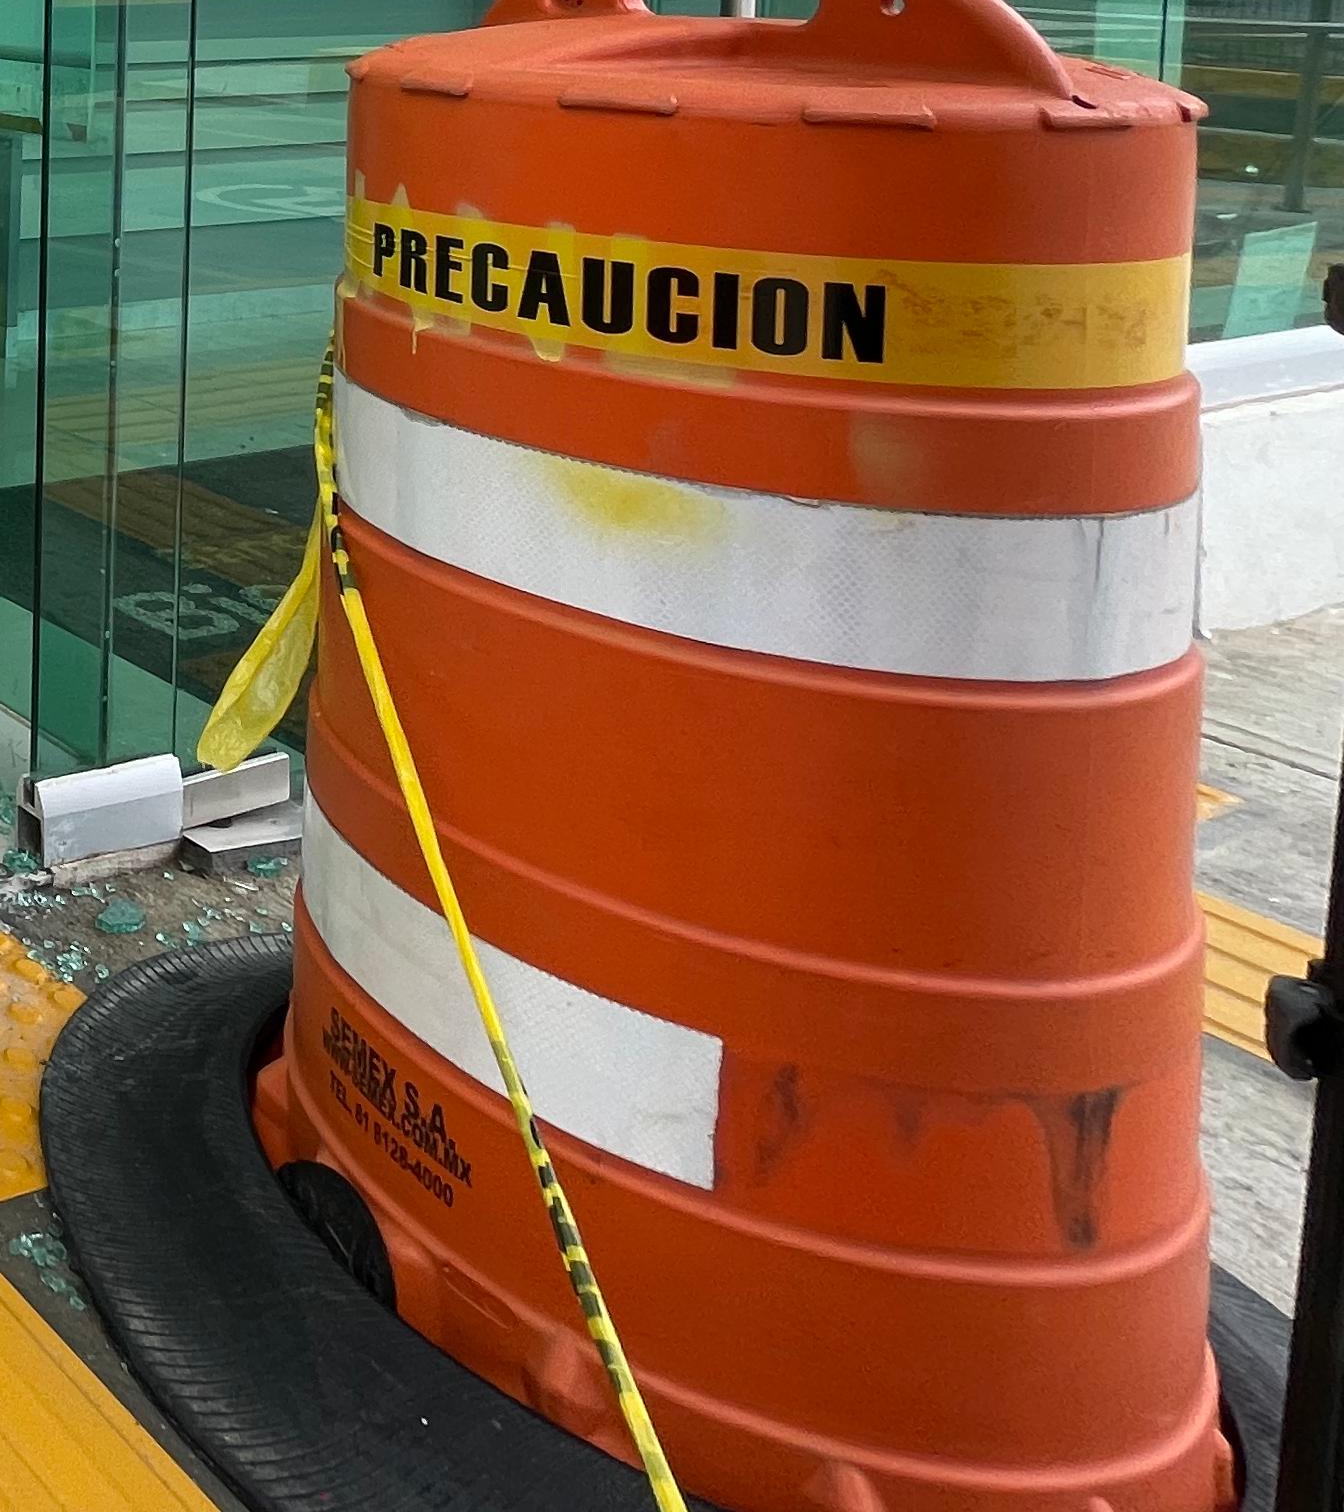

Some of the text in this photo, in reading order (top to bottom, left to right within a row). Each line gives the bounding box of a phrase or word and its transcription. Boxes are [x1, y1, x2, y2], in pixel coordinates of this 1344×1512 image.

[371, 221, 888, 365] PRECAUCION
[330, 1006, 396, 1090] SEMEX
[355, 1103, 369, 1132] 81
[374, 1122, 453, 1207] 8128-4000
